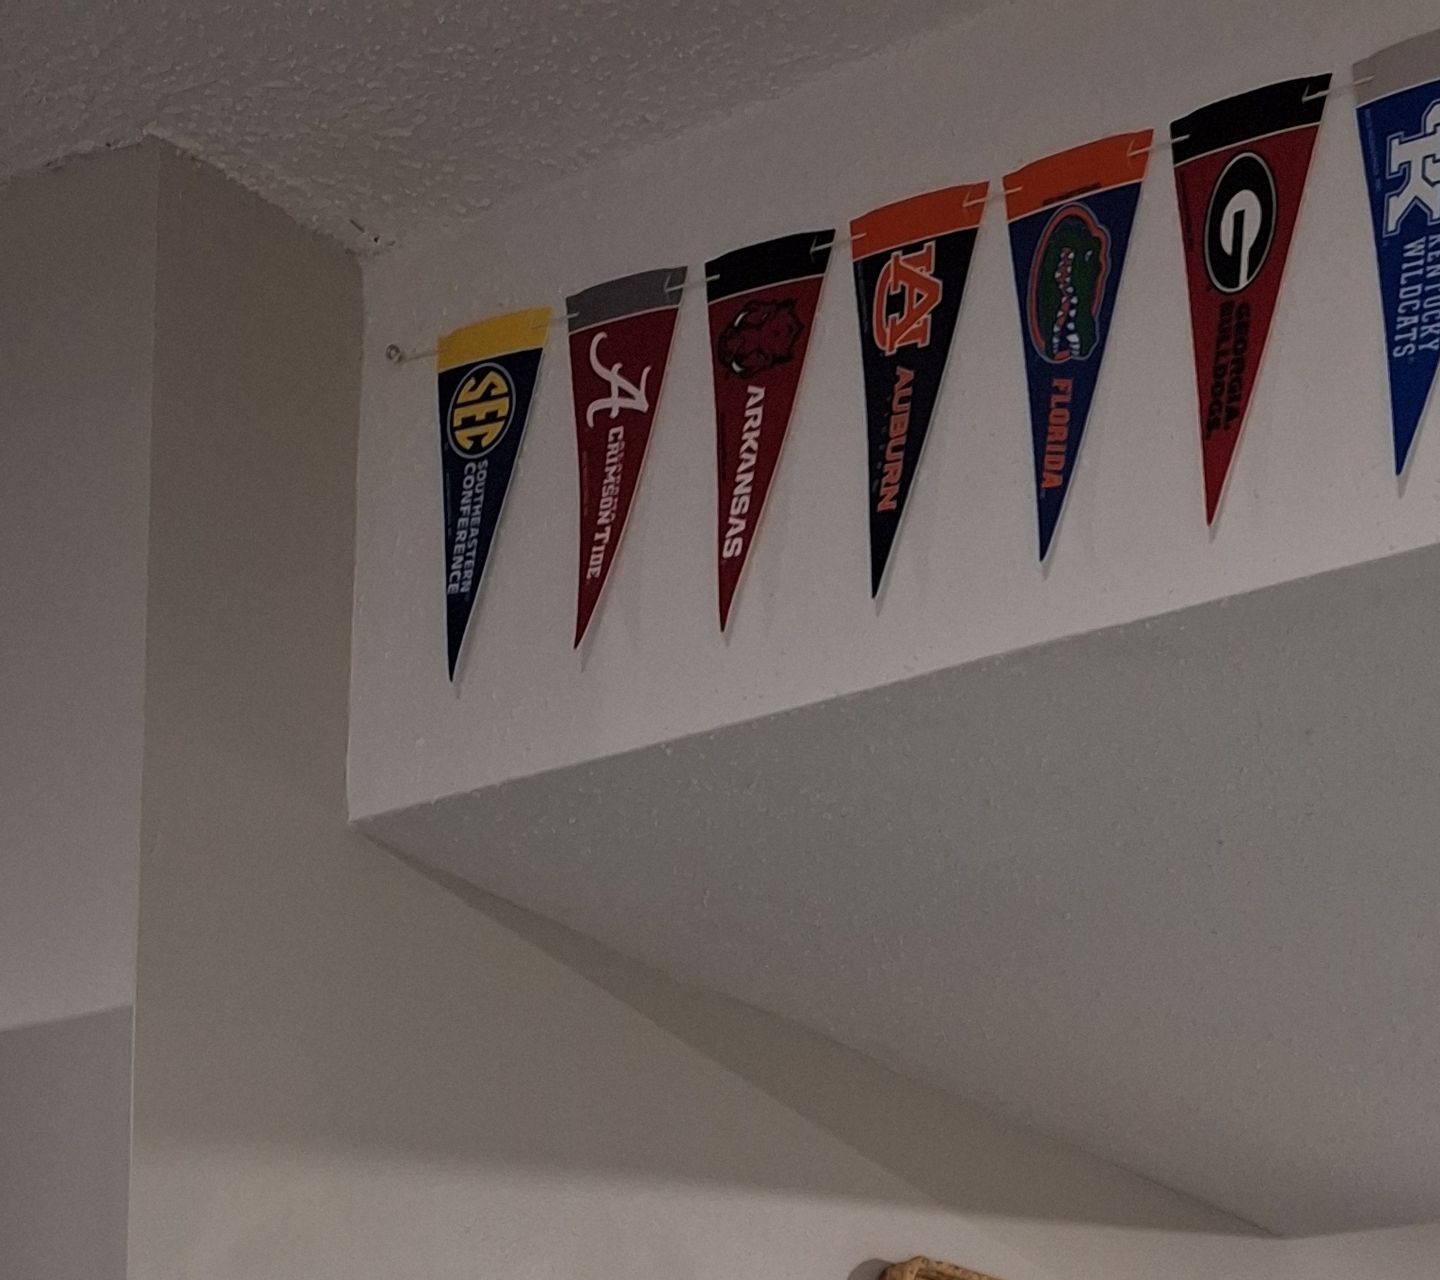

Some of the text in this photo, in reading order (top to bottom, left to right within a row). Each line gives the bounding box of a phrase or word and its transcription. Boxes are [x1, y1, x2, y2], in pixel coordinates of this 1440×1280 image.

[1392, 236, 1427, 358] WILDCATS
[451, 369, 510, 451] SEC
[1206, 300, 1237, 433] BULLDOGS
[1223, 301, 1252, 427] GEORGIA
[597, 424, 624, 525] CRIMSON
[722, 384, 766, 559] ARKANSAS
[877, 366, 915, 512] AUBURN
[1041, 377, 1074, 489] FLORIDA
[447, 461, 477, 594] CONFERENCE
[460, 459, 489, 593] SOUTHEASTERN
[586, 524, 612, 580] TIDE
